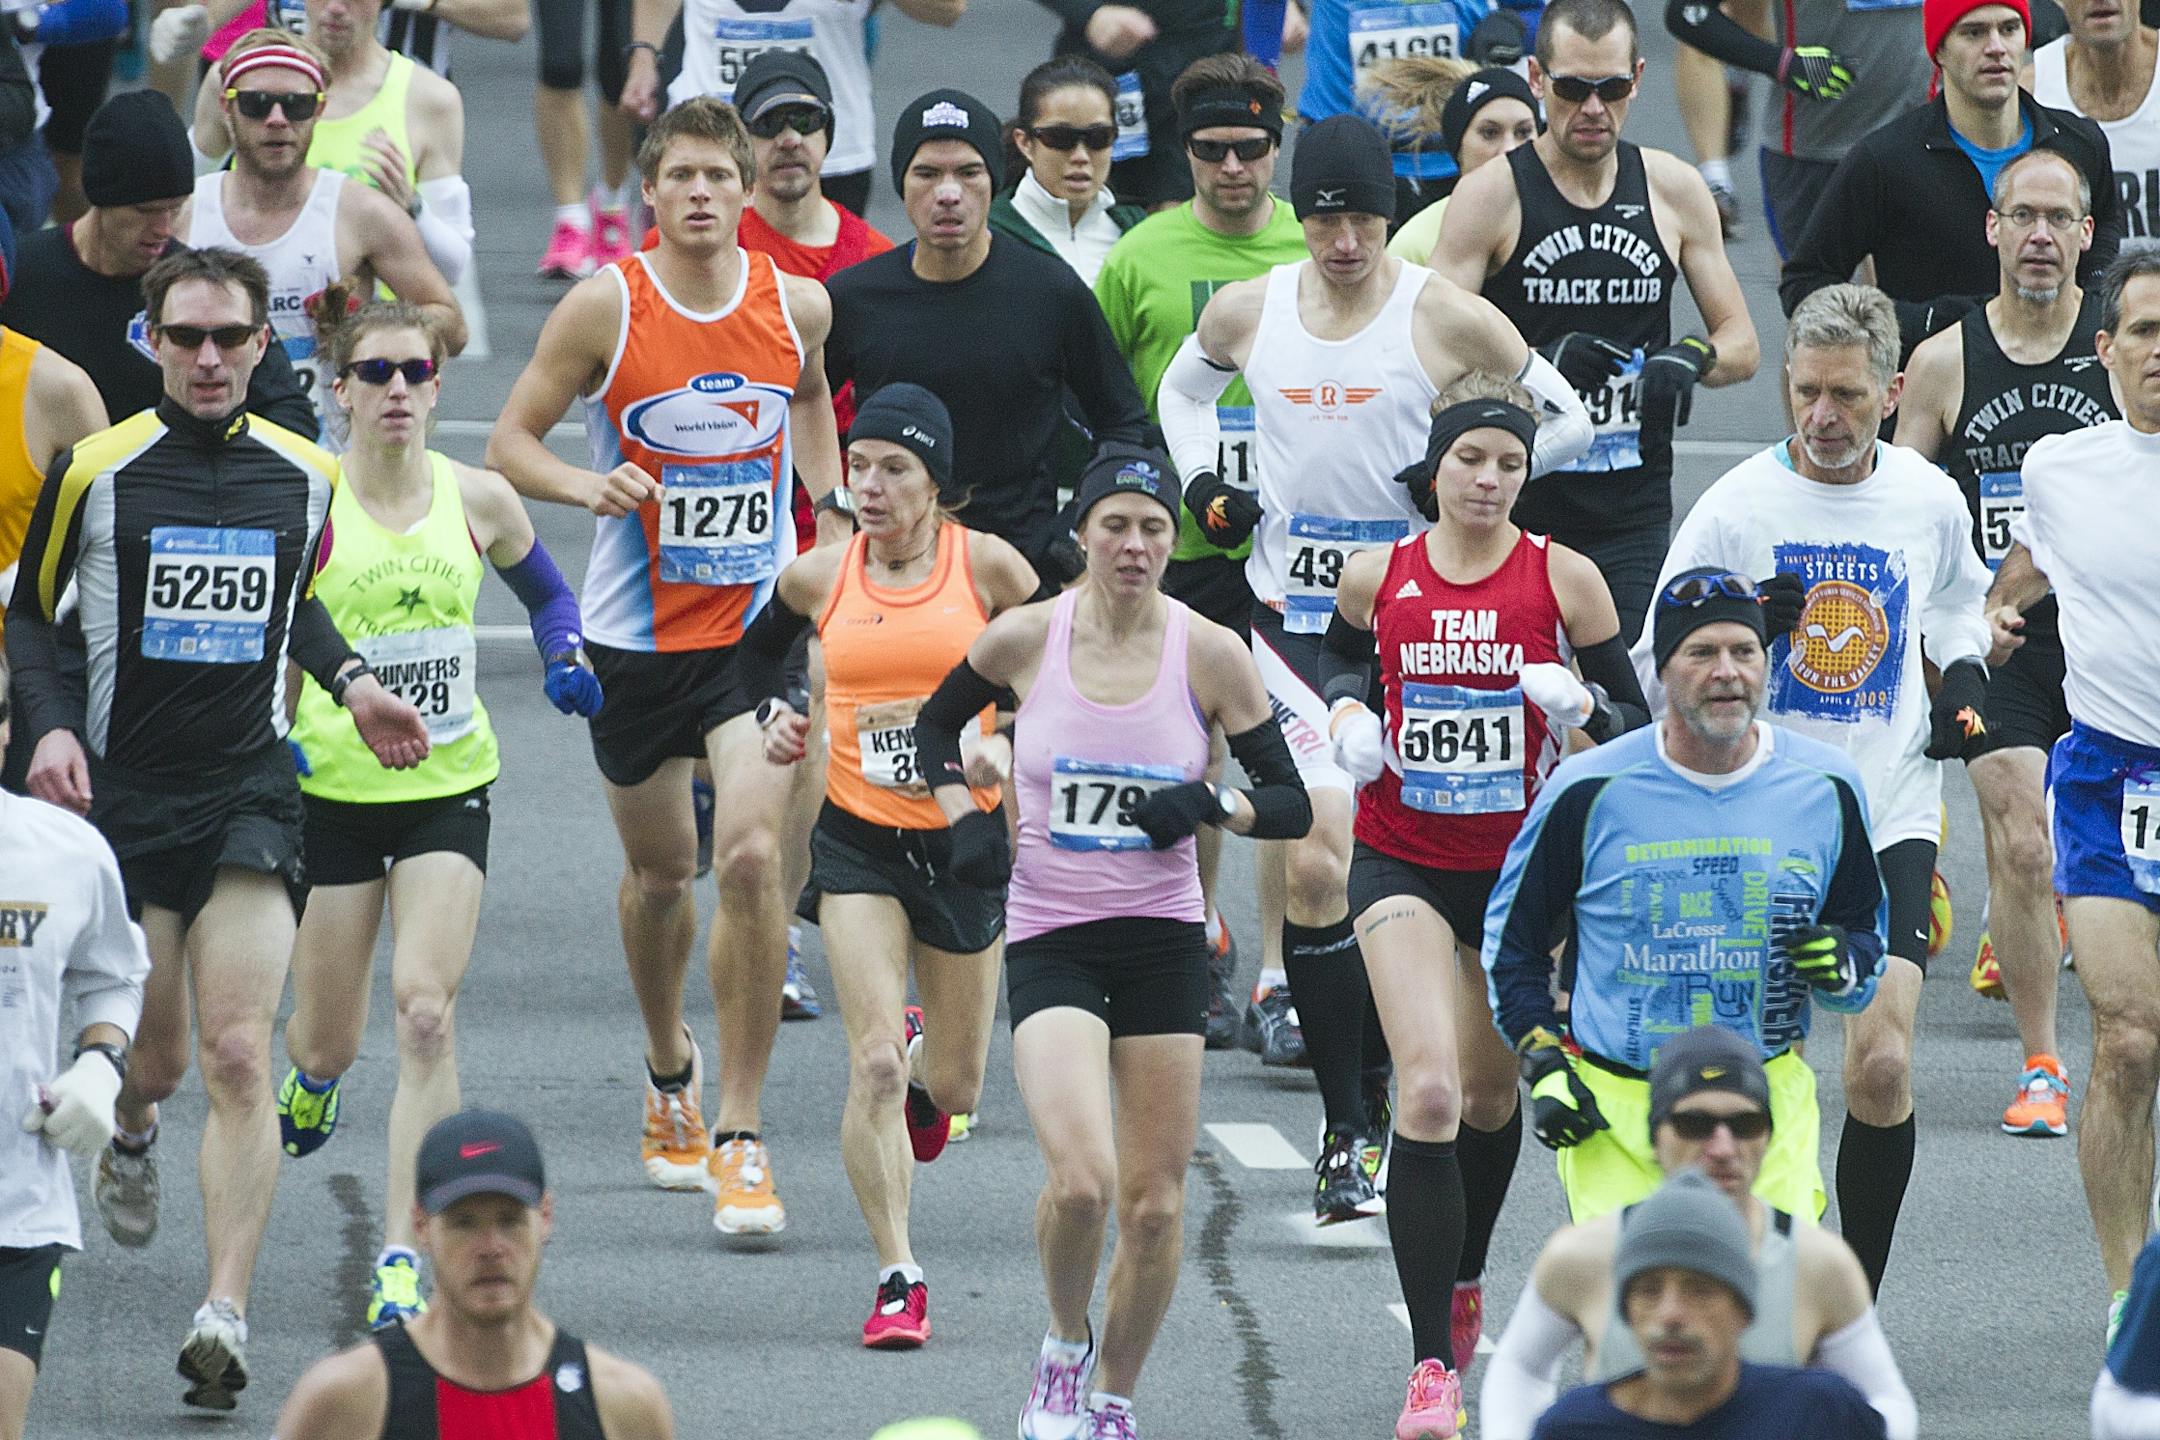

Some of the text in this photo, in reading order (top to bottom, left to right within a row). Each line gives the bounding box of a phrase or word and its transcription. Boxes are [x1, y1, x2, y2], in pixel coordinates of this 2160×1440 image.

[1523, 223, 1661, 277] TWIN CITIES
[269, 295, 300, 312] RC
[1523, 278, 1661, 304] TRACK CLUB
[700, 376, 736, 390] team
[675, 421, 738, 433] World Vision
[1964, 387, 2024, 444] TWIN
[1965, 440, 2034, 470] TRAC
[668, 491, 768, 538] 1276
[1986, 506, 2025, 550] 5
[350, 554, 465, 594] TWIN CITIES
[1289, 546, 1368, 589] 43
[1805, 561, 1878, 582] STREETS
[152, 563, 267, 613] 5259
[1431, 609, 1498, 642] TEAM
[1399, 642, 1525, 677] NEBRASKA
[1796, 644, 1881, 688] RUN THE VALLEY
[1819, 695, 1842, 705] APRIL
[1854, 691, 1887, 708] 2009
[1403, 715, 1512, 765] 5641
[1624, 836, 1773, 864] DETERMINATION
[1692, 855, 1740, 876] SPEED
[1742, 870, 1770, 937] DRIVE
[0, 908, 47, 948] RY
[1652, 921, 1727, 939] LaCrosse
[1623, 937, 1761, 972] Marathon
